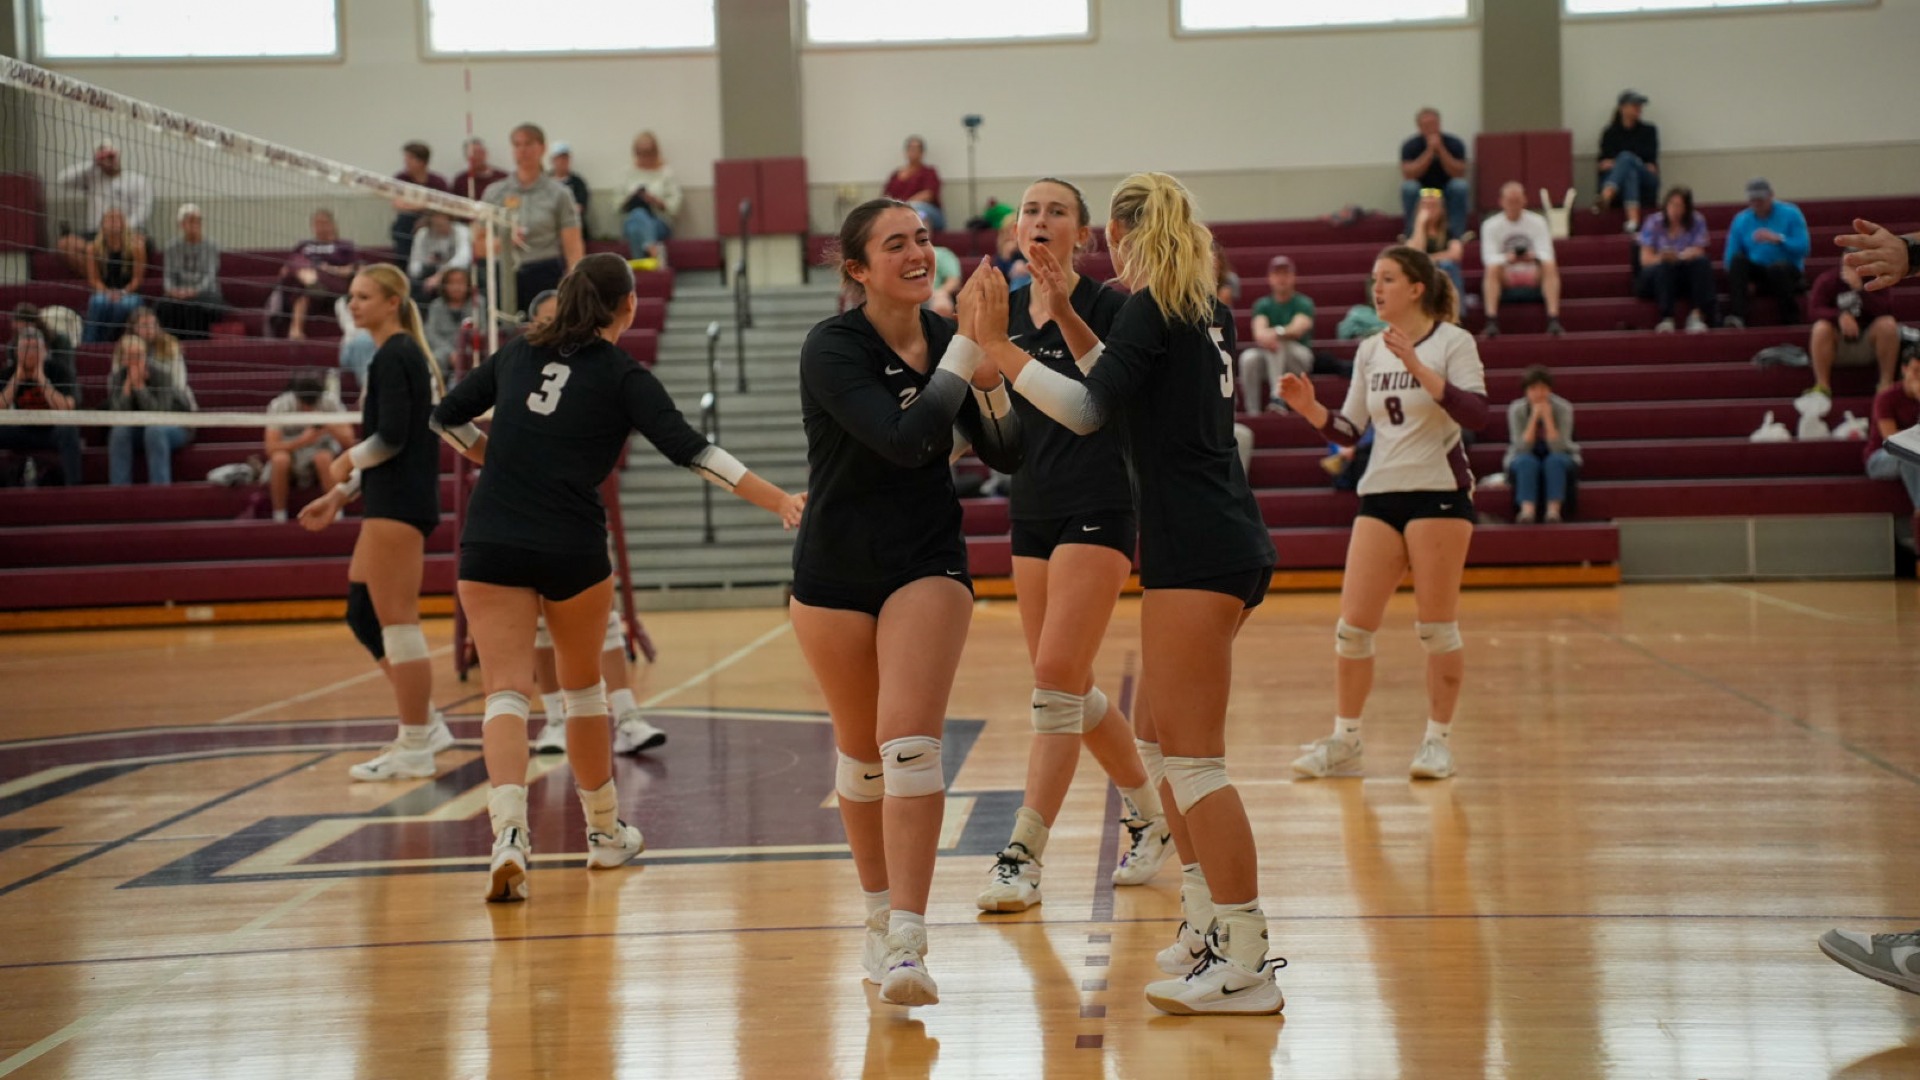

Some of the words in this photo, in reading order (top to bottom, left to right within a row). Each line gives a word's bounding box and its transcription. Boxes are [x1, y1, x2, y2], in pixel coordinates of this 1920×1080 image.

[526, 361, 571, 416] 3
[1208, 327, 1234, 398] 5
[1385, 396, 1404, 426] 8
